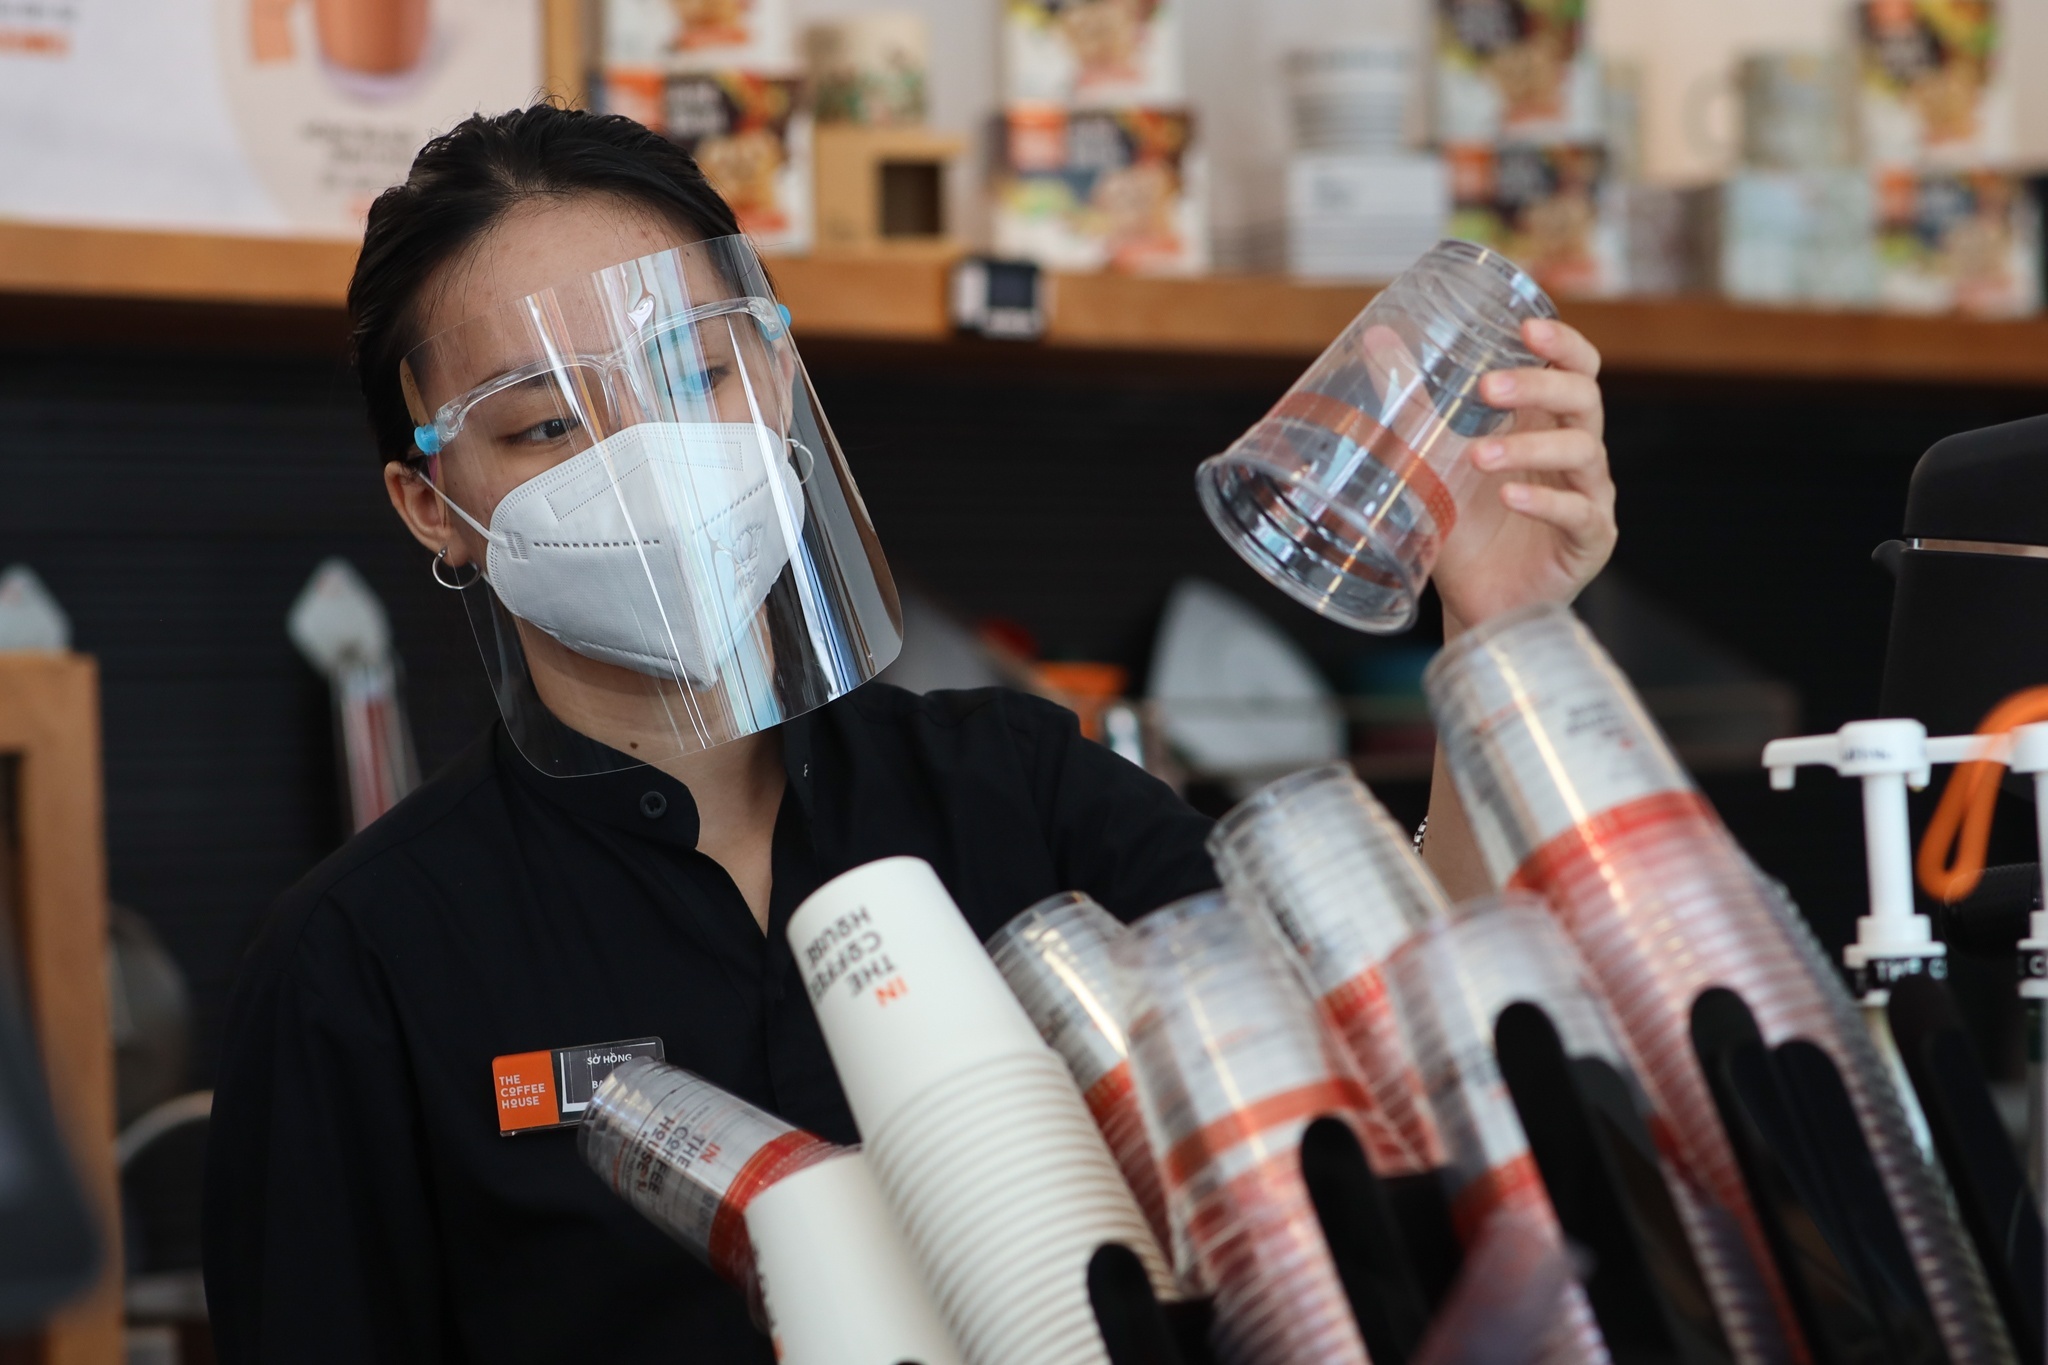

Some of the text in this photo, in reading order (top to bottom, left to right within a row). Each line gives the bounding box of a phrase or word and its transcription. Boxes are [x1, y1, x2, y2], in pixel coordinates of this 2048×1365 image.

[805, 905, 871, 968] HOUSE
[847, 954, 896, 998] THE
[875, 976, 908, 1008] IN
[498, 1074, 521, 1086] THE
[500, 1083, 546, 1098] COFFEE
[501, 1096, 540, 1110] HOUSE
[636, 1115, 676, 1172] HOUSE
[648, 1125, 689, 1196] COFFEE
[676, 1134, 706, 1170] THE
[700, 1141, 721, 1165] IN
